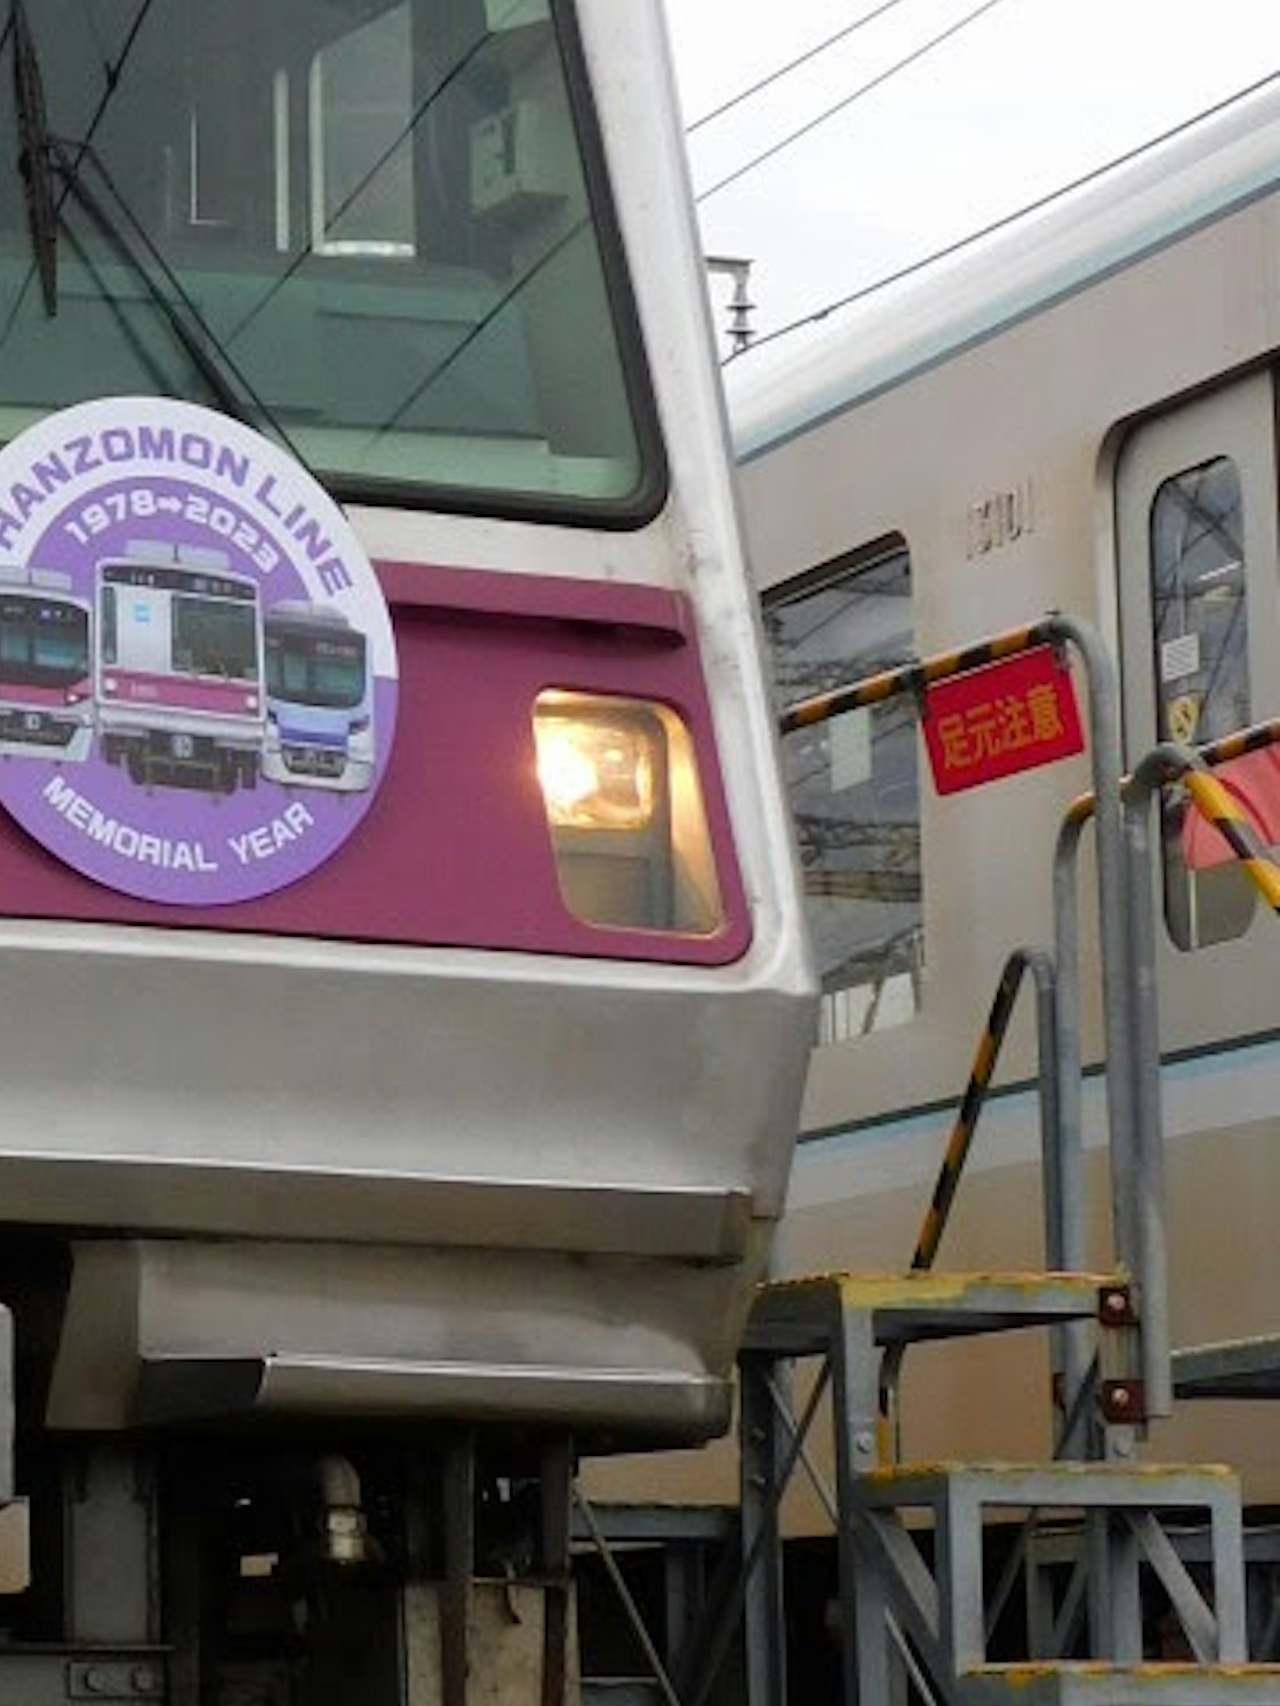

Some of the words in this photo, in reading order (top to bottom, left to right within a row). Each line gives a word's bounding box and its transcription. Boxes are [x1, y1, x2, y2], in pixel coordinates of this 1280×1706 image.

[255, 474, 353, 595] LINE
[938, 683, 1066, 770] 足元注意
[42, 774, 218, 873] MEMORIAL
[227, 801, 314, 866] YEAR
